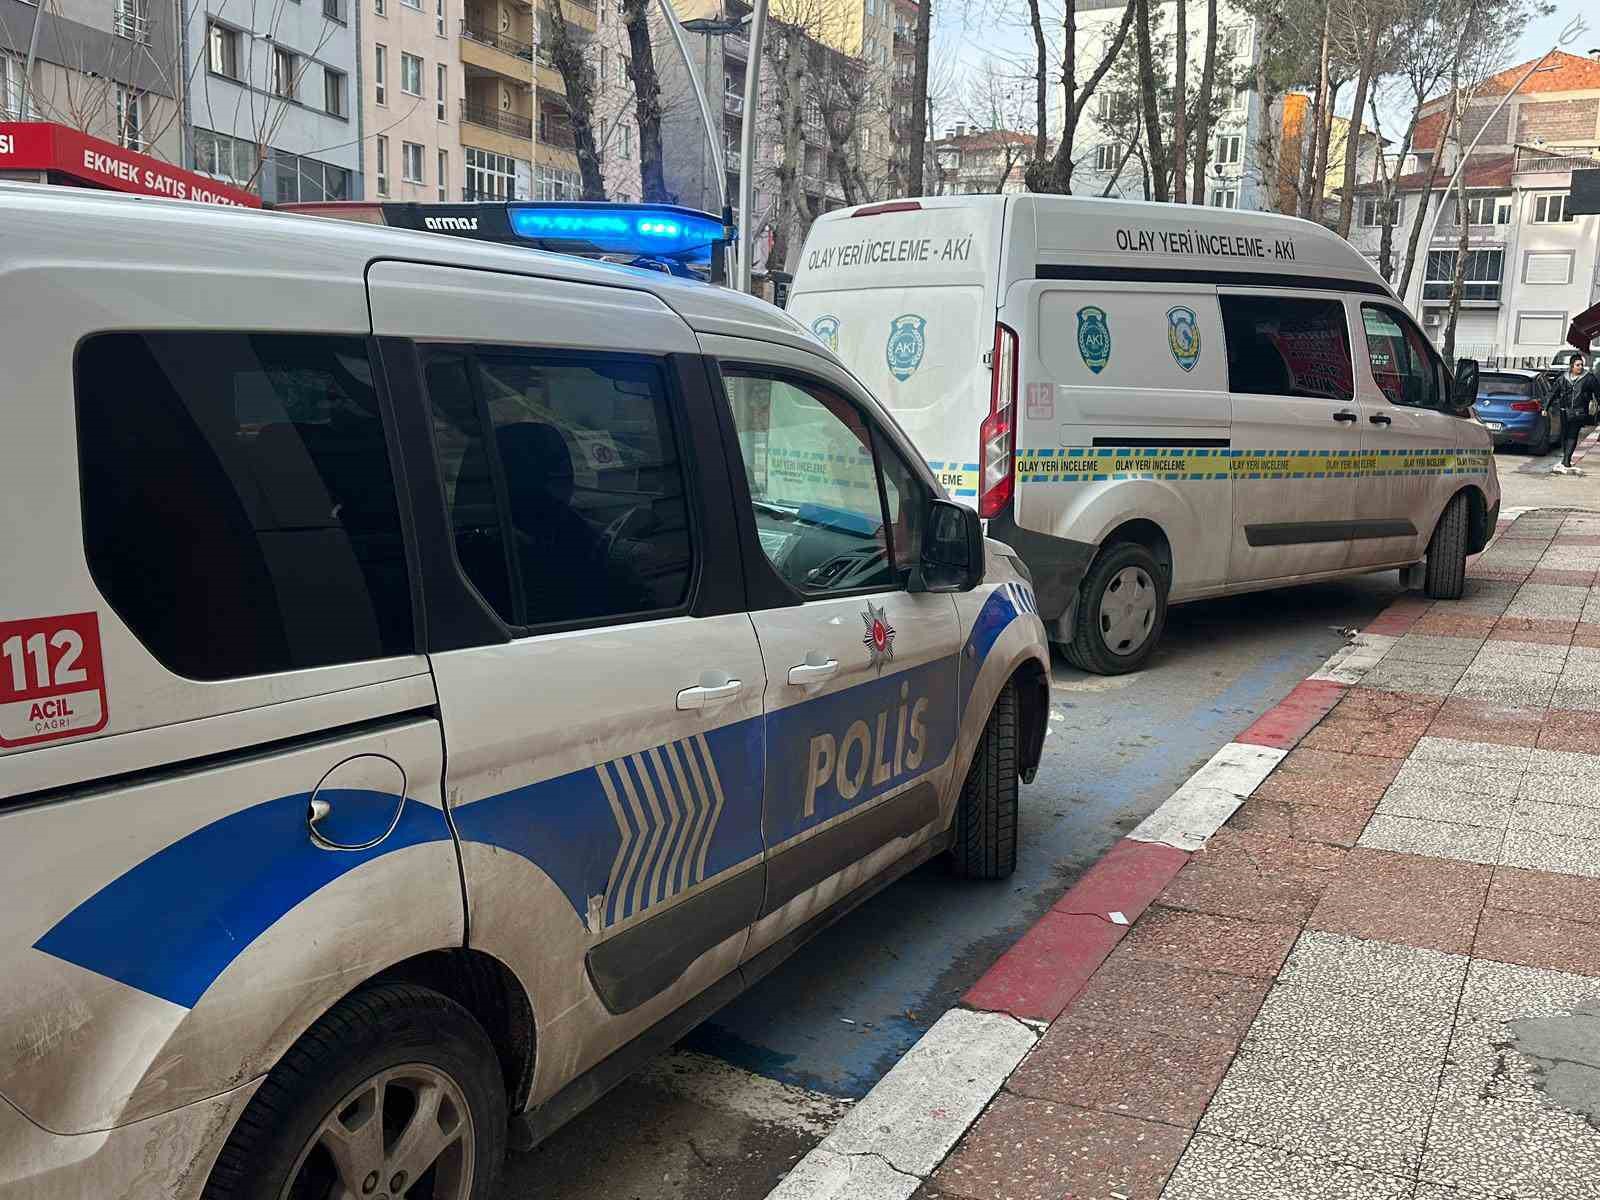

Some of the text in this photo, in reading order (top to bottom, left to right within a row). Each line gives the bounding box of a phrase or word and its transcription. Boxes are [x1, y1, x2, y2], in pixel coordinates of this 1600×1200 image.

[83, 149, 140, 185] EKMEK
[144, 170, 186, 199] SATIŞ
[424, 217, 478, 230] armas
[808, 248, 836, 271] OLAY
[941, 233, 973, 262] AKİ
[1116, 229, 1155, 252] OLAY
[1158, 229, 1194, 254] YERİ
[1194, 230, 1265, 258] İNCELEME
[1275, 237, 1297, 261] AKİ
[1018, 460, 1040, 472] OLAY
[1115, 459, 1134, 471] OLAY
[2, 629, 88, 692] 112
[804, 680, 930, 817] POLİS
